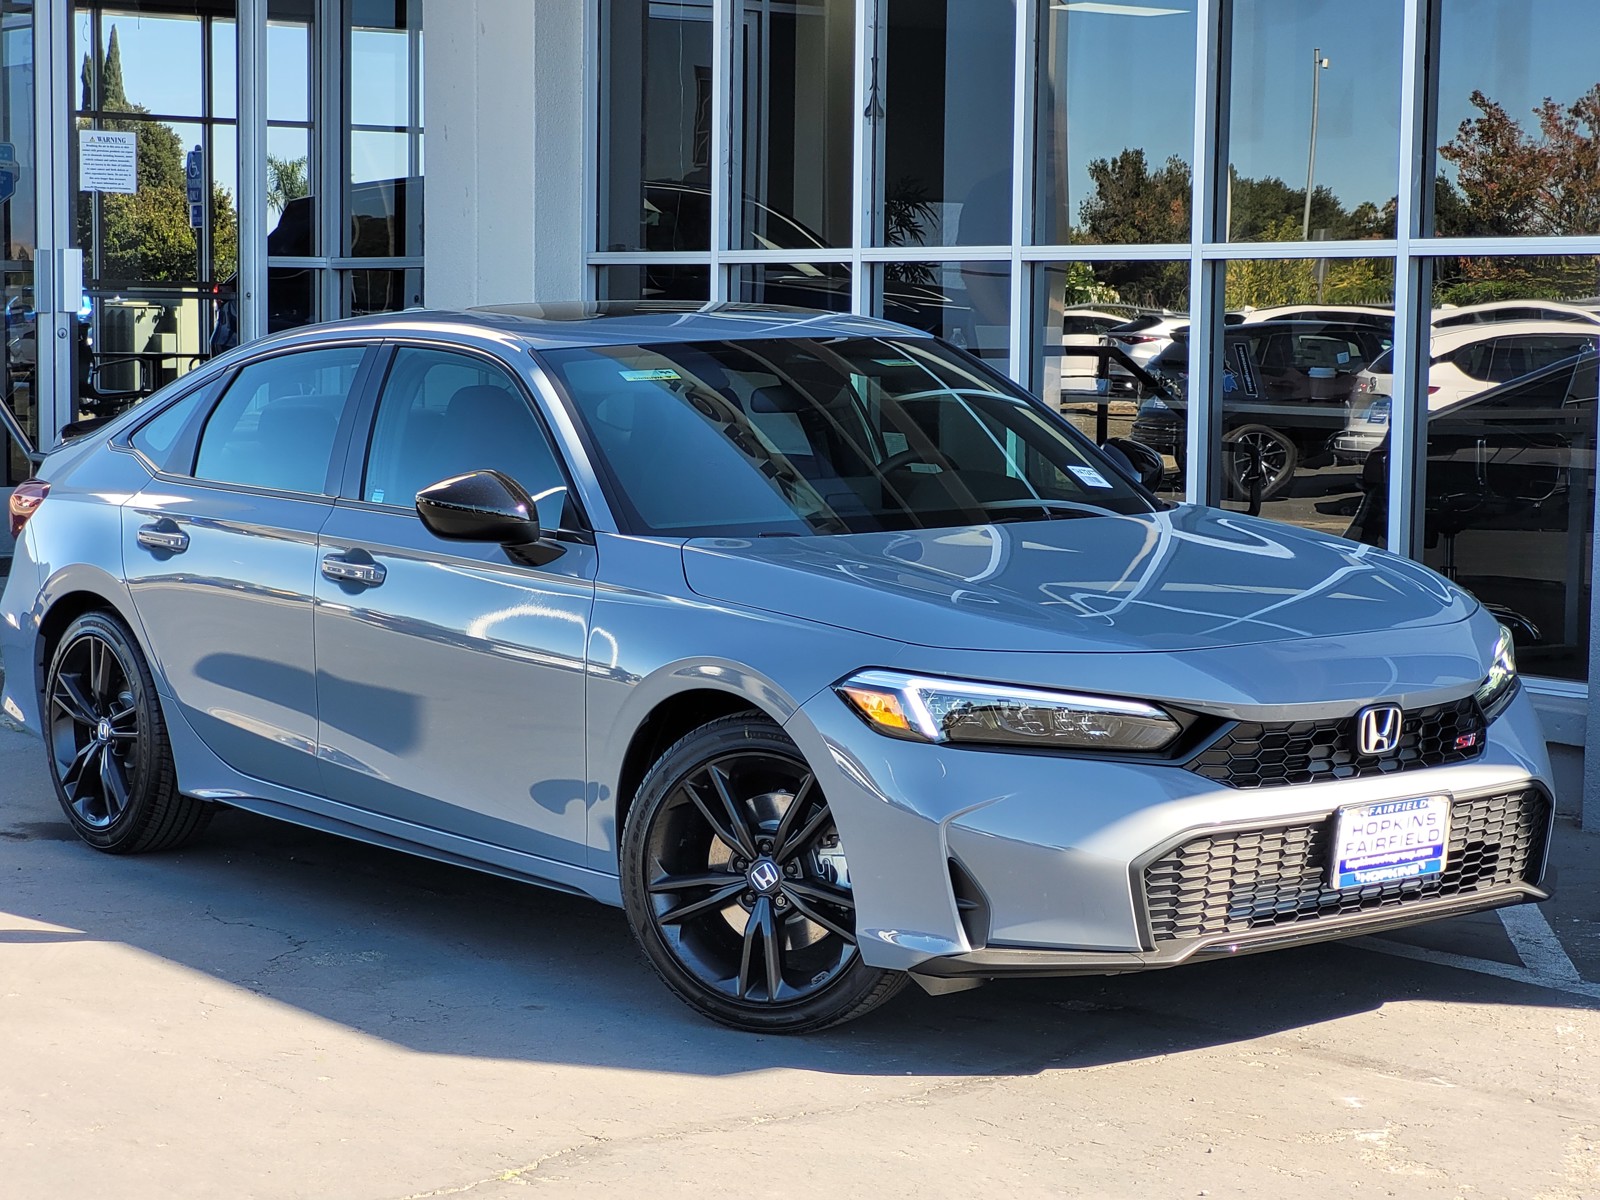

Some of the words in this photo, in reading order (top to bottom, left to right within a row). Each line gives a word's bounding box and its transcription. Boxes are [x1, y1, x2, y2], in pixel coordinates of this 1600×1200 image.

[1369, 800, 1429, 816] FAIRFIELD
[1352, 813, 1437, 836] HOPKINS
[1345, 829, 1440, 855] FAIRFIELD
